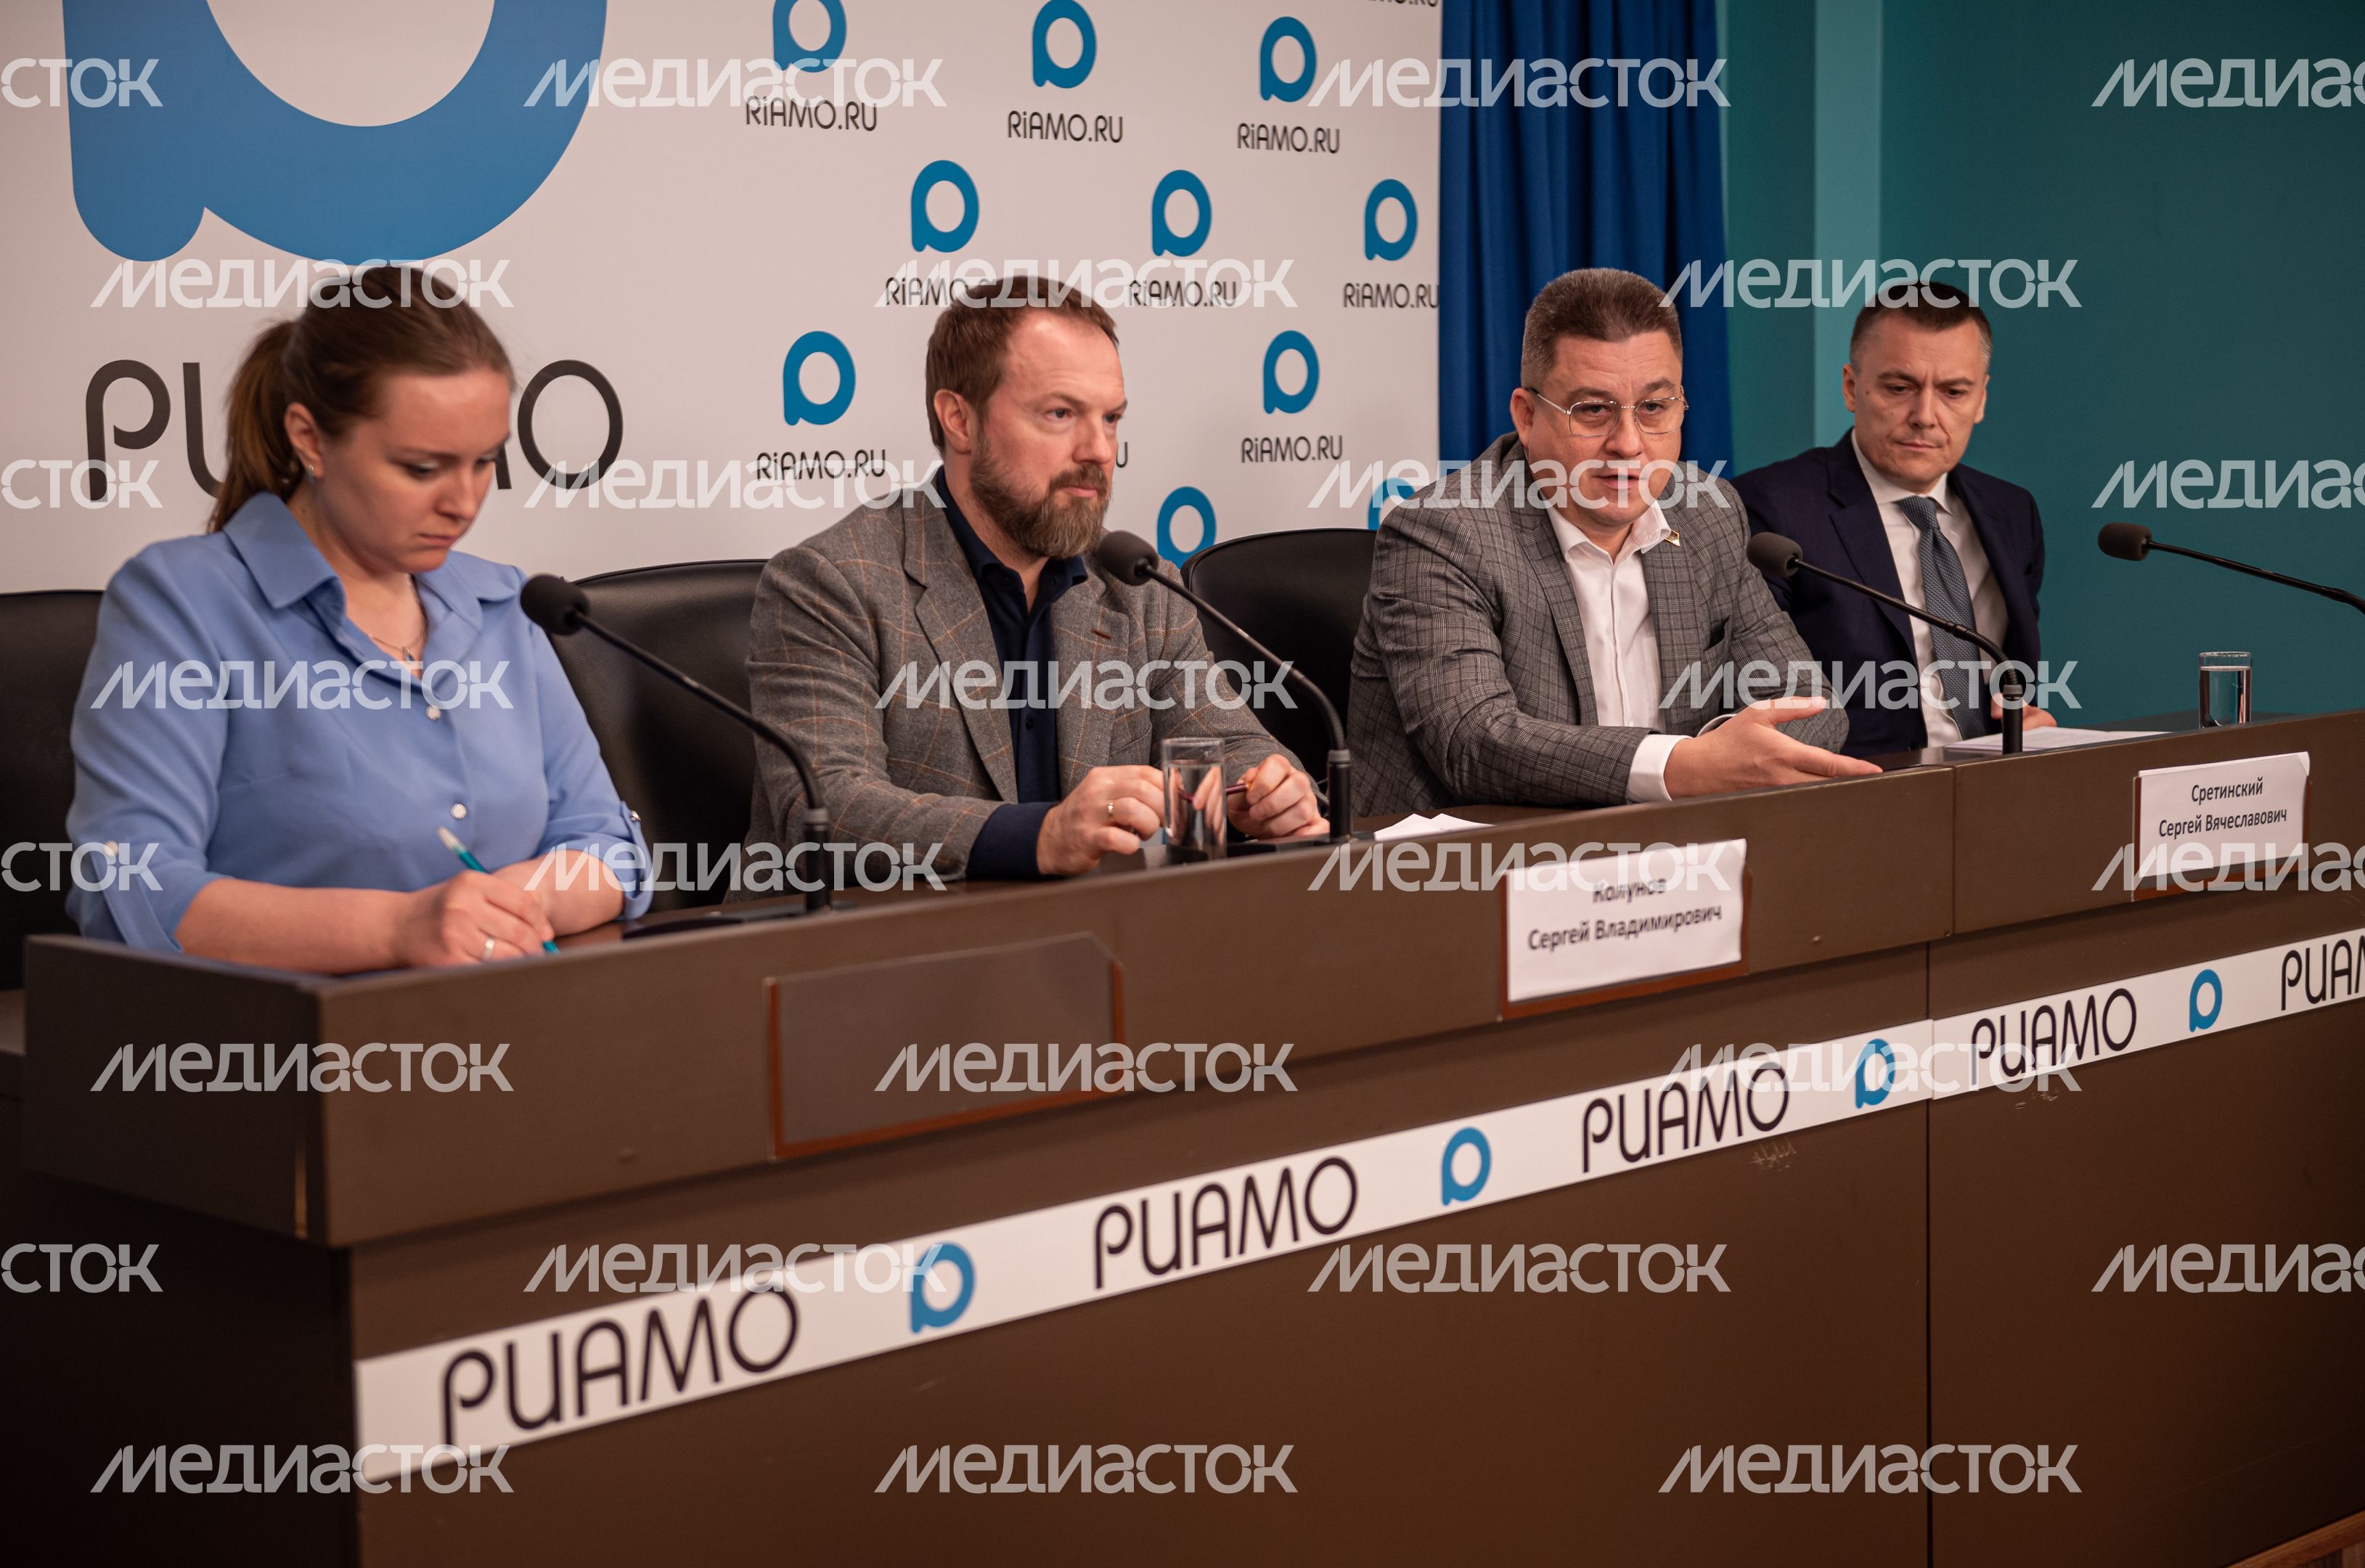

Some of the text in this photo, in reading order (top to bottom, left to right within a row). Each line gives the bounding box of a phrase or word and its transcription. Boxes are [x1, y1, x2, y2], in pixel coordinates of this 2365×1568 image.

[2191, 777, 2263, 806] Сретинский
[2159, 808, 2287, 840] Сергей Вячеславович
[1527, 903, 1723, 952] Сергей Владимирович
